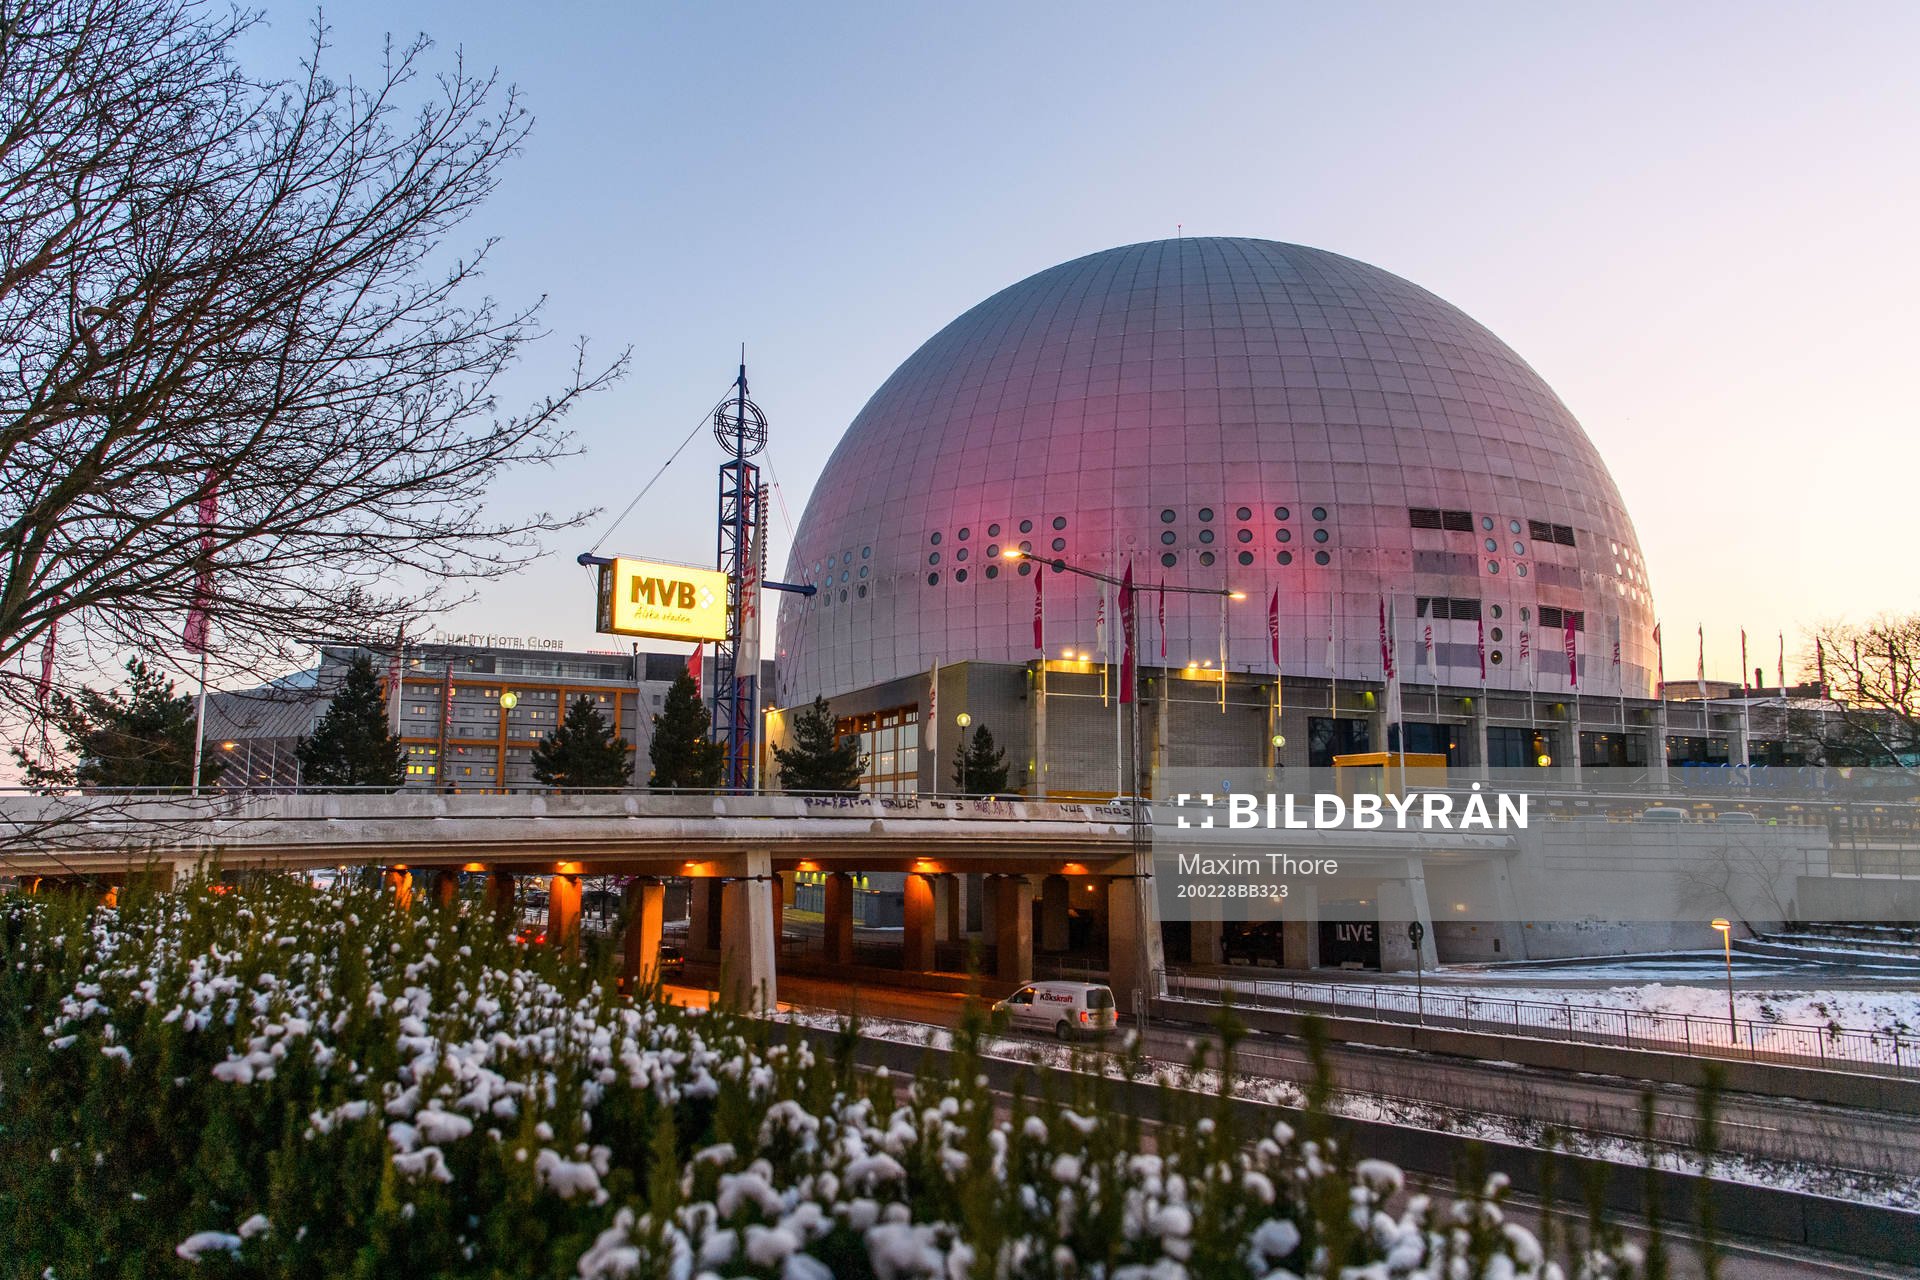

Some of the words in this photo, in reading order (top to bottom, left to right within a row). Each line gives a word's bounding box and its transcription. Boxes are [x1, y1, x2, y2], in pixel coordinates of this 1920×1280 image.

[631, 575, 696, 609] MVB
[488, 633, 524, 648] HOTEL
[528, 636, 564, 649] GLOBE
[1336, 924, 1373, 942] LIVE
